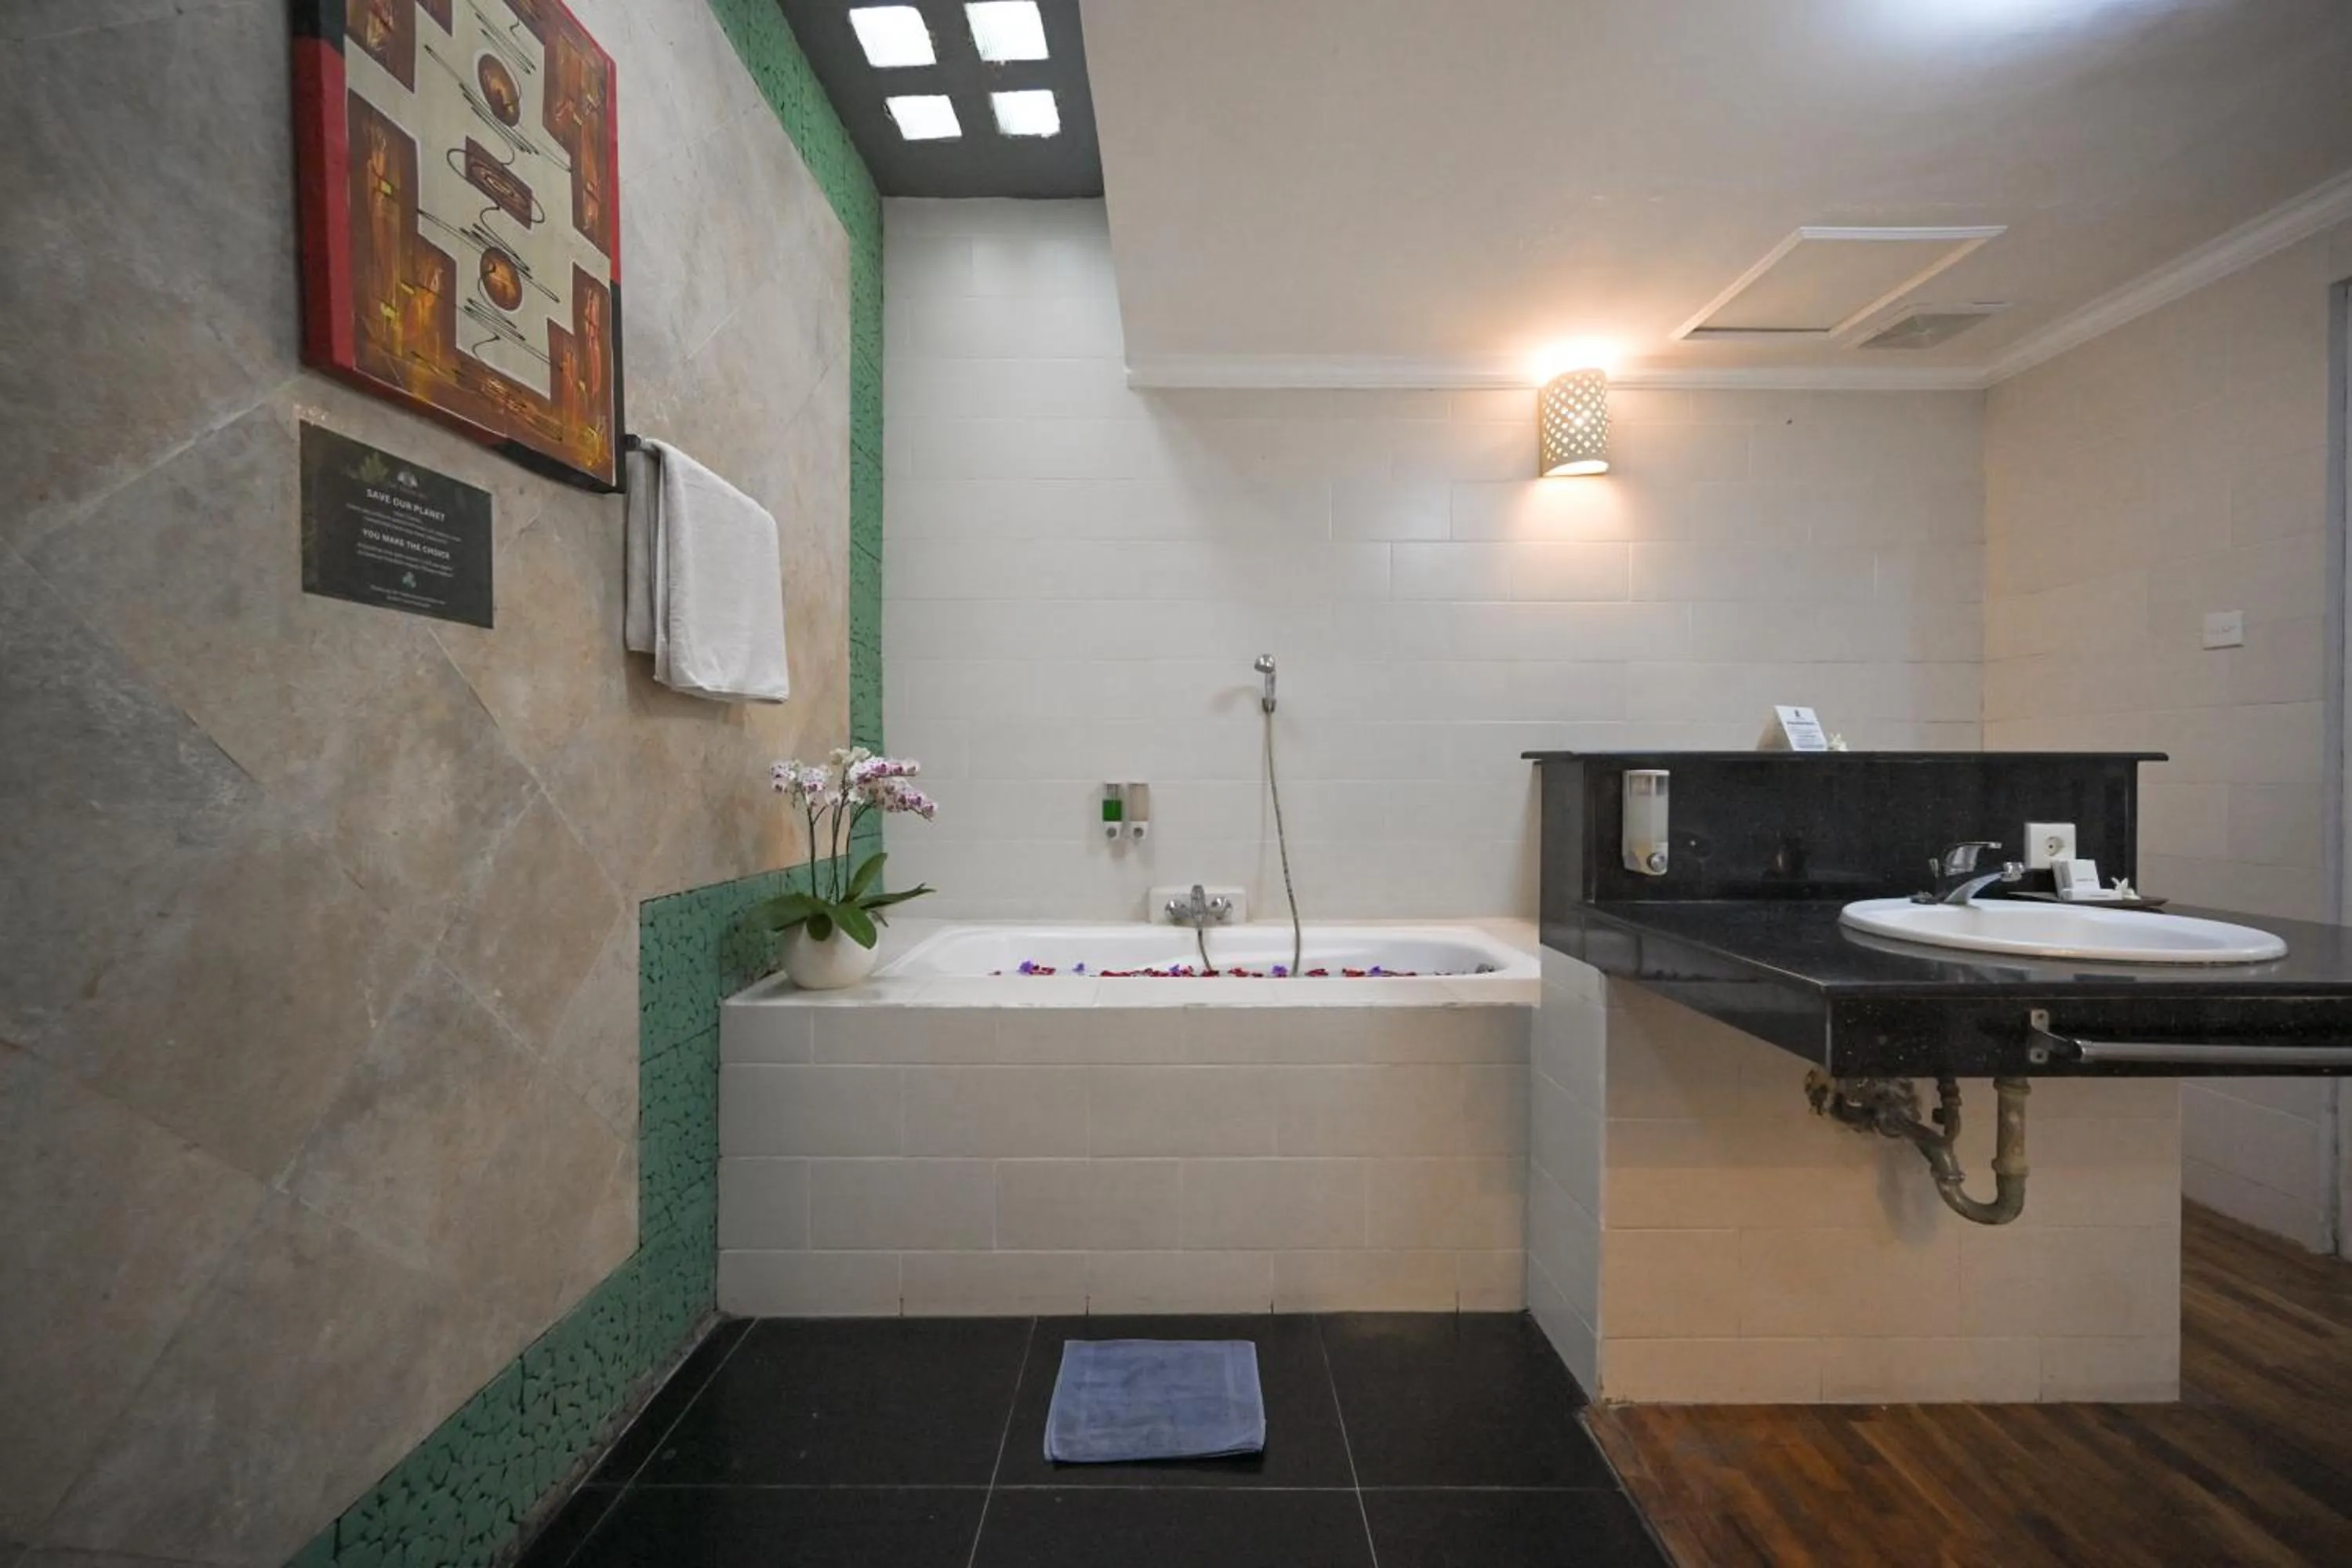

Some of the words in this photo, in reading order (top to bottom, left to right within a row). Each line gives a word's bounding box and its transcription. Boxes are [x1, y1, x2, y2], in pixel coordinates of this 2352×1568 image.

[366, 488, 391, 503] SAVE
[393, 497, 412, 510] OUR
[413, 505, 445, 521] PLANET
[363, 528, 380, 540] YOU
[383, 534, 405, 546] MAKE
[406, 541, 421, 552] THE
